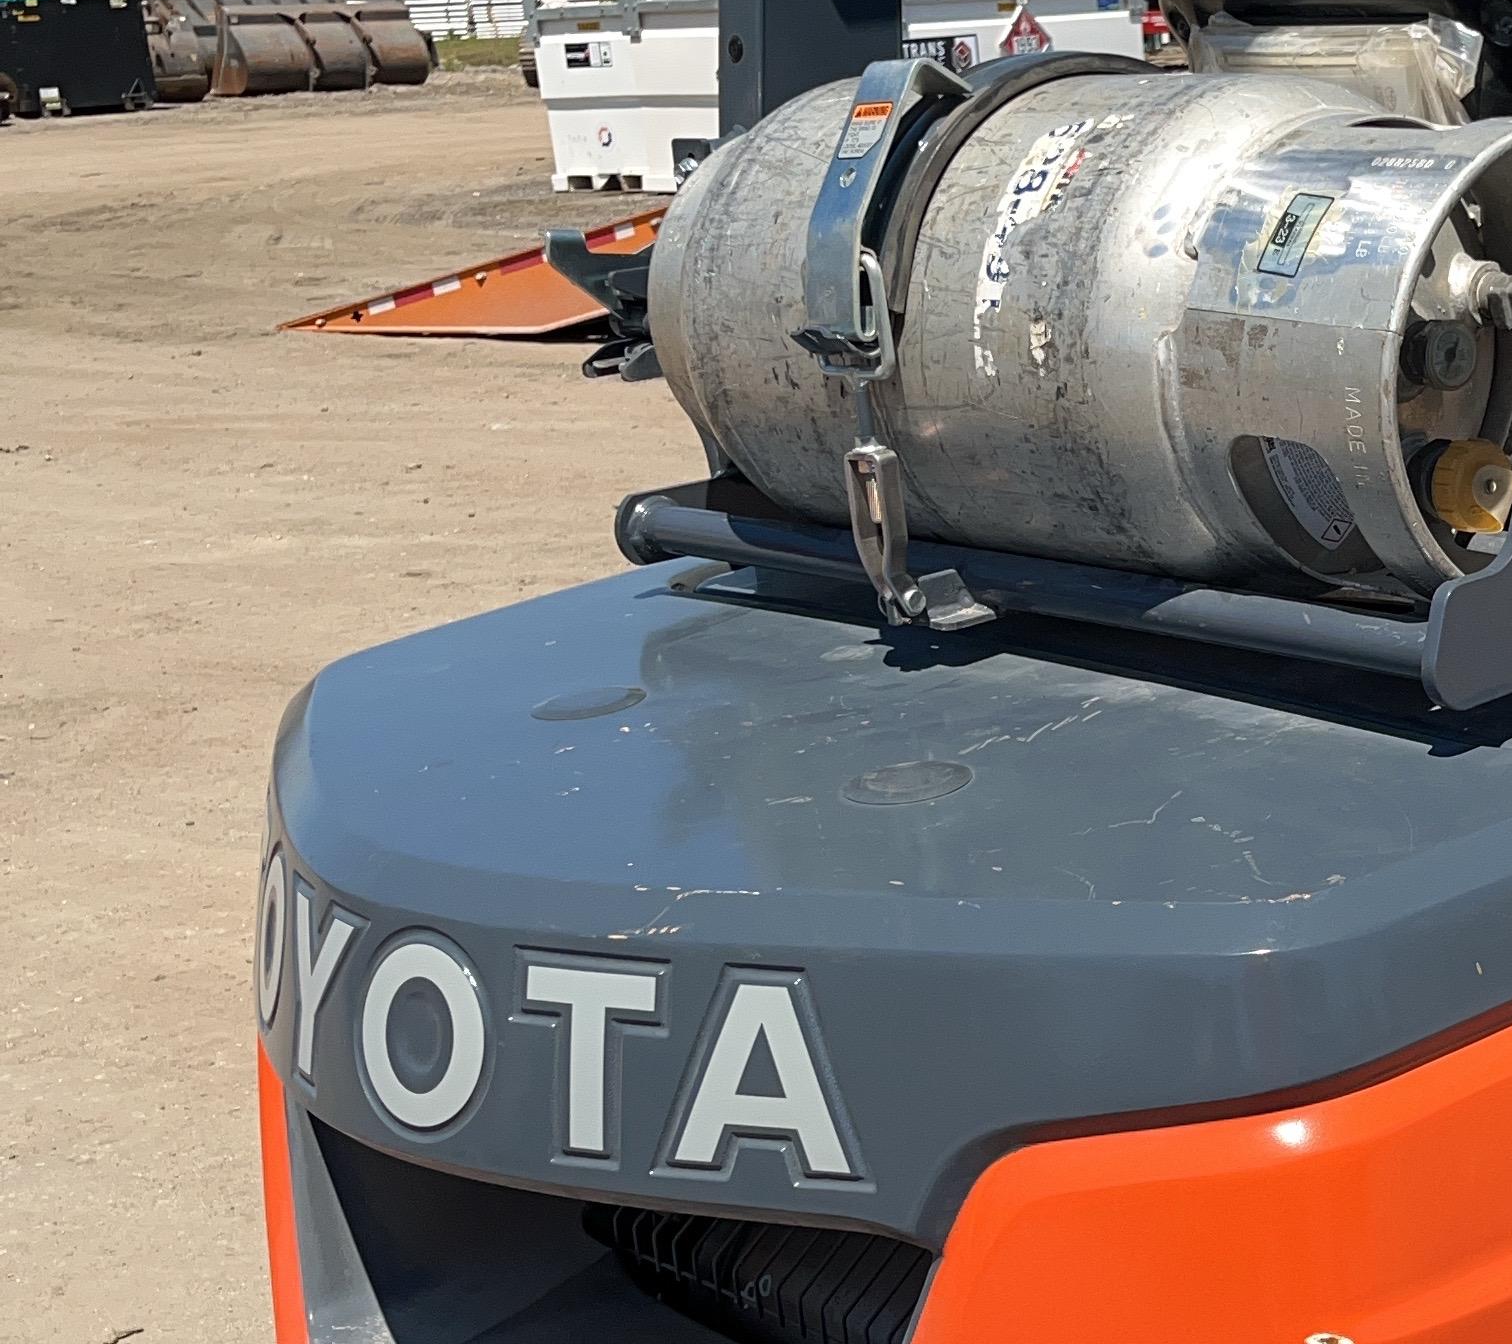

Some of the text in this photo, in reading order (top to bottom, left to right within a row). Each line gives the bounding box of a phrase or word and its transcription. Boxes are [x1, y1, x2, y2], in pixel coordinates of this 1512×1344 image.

[1274, 213, 1297, 244] 3-23
[1344, 386, 1368, 455] MADE
[259, 853, 855, 1177] OYOTA
